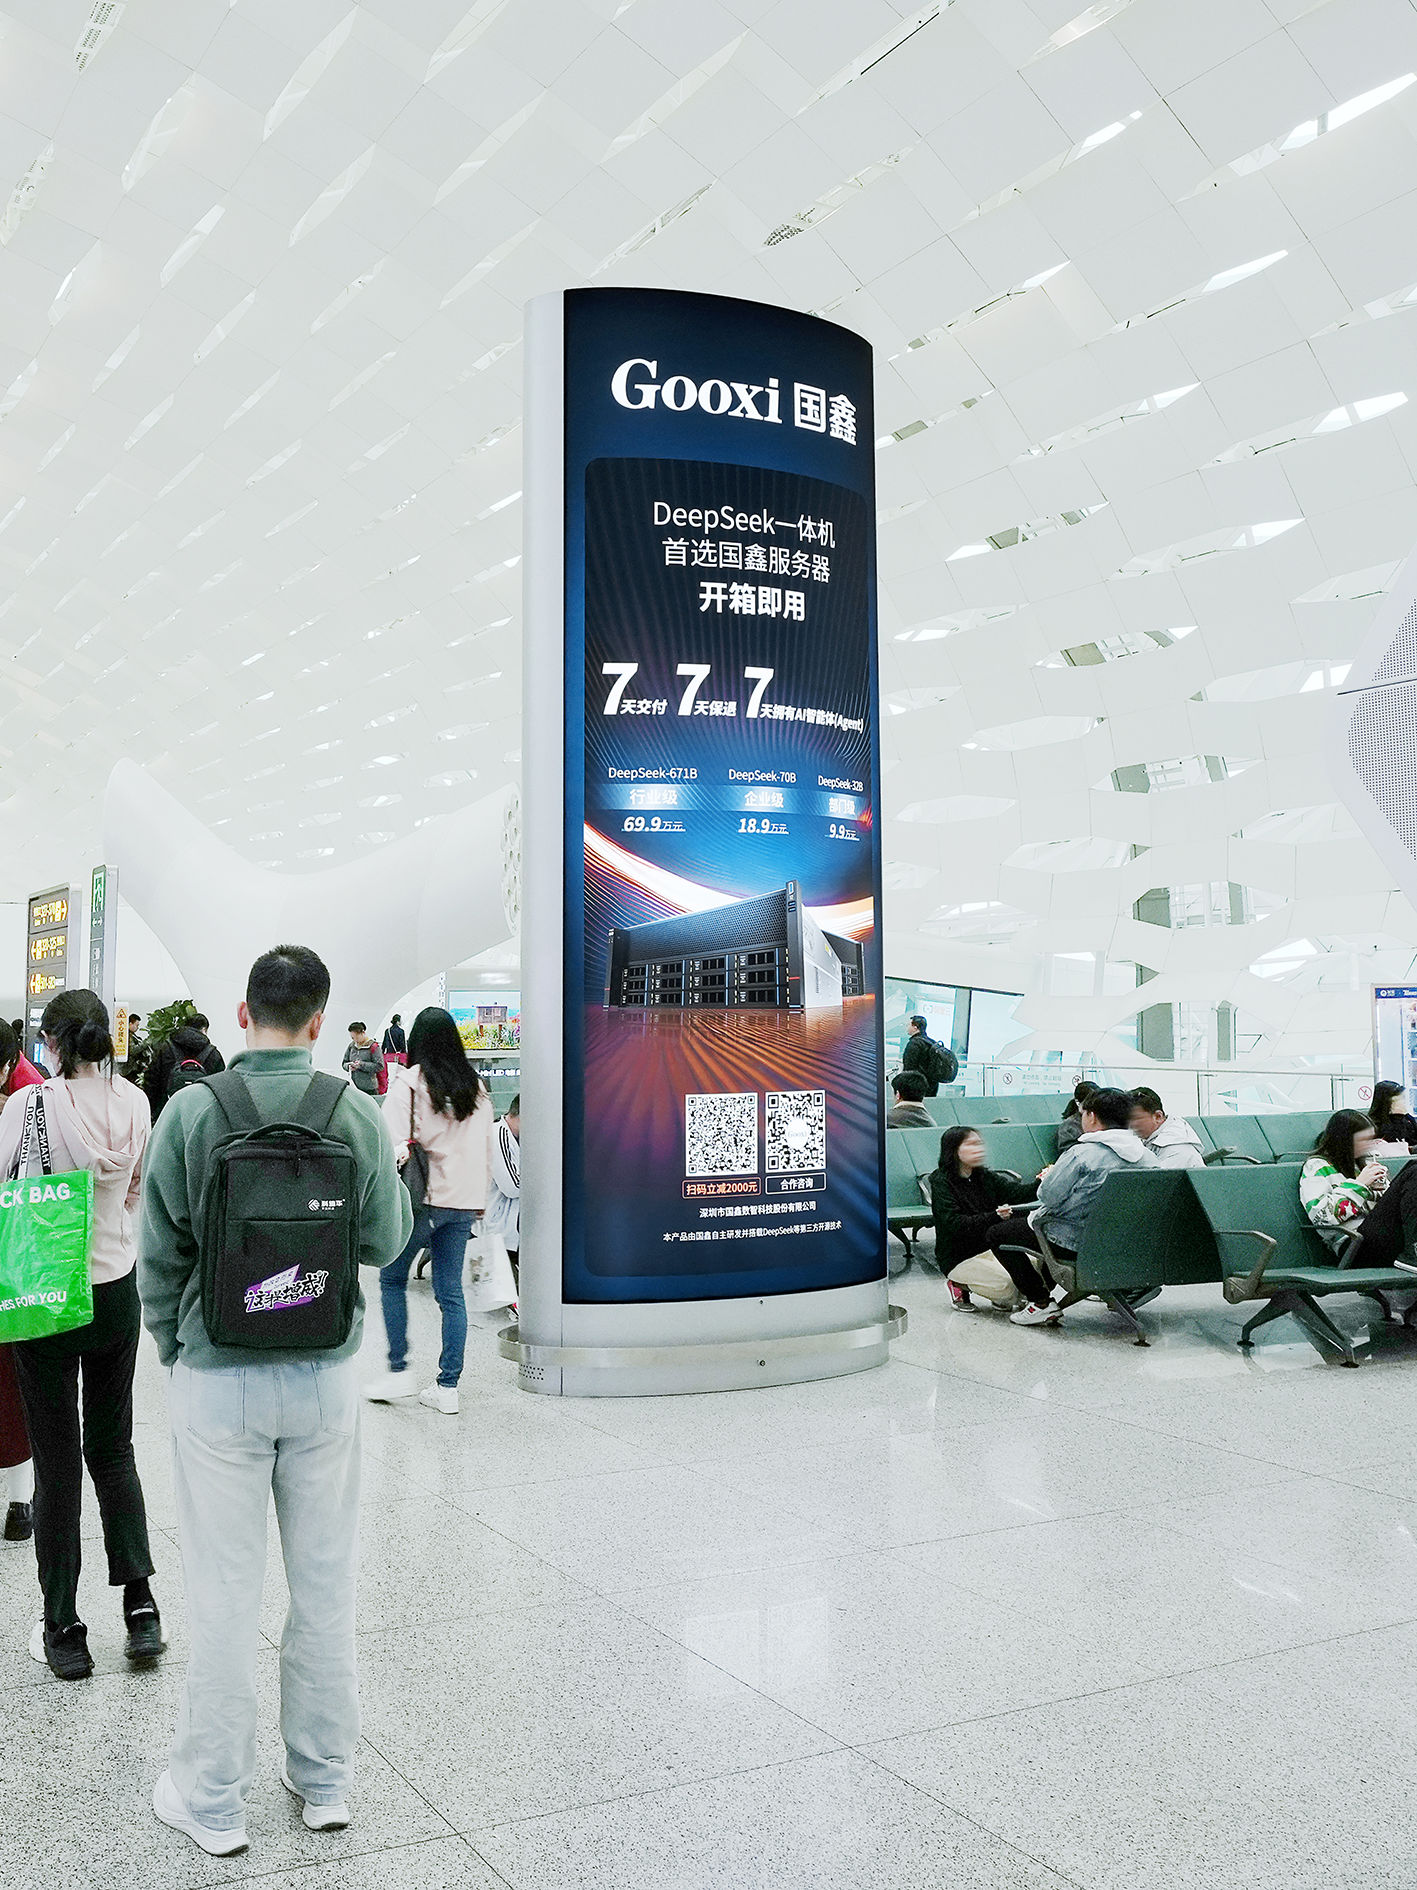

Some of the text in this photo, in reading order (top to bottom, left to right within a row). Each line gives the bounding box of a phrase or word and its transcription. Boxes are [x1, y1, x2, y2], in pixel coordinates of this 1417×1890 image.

[610, 357, 857, 446] Gooxi 国鑫
[652, 501, 836, 549] DeepSeek一体机
[661, 537, 831, 583] 首选国鑫服务器
[699, 581, 806, 622] 开箱即用
[608, 767, 864, 792] DeepSeek-671B DeepSeek-70B DeepSeek-32B
[629, 788, 856, 815] 行业级 企业级 部门级
[21, 1106, 35, 1166] THANK YOU
[29, 1183, 70, 1203] BAG
[686, 1181, 758, 1196] 扫码立减2000元
[780, 1177, 814, 1191] 合作咨询
[15, 1295, 35, 1308] FOR
[39, 1291, 67, 1304] YOU
